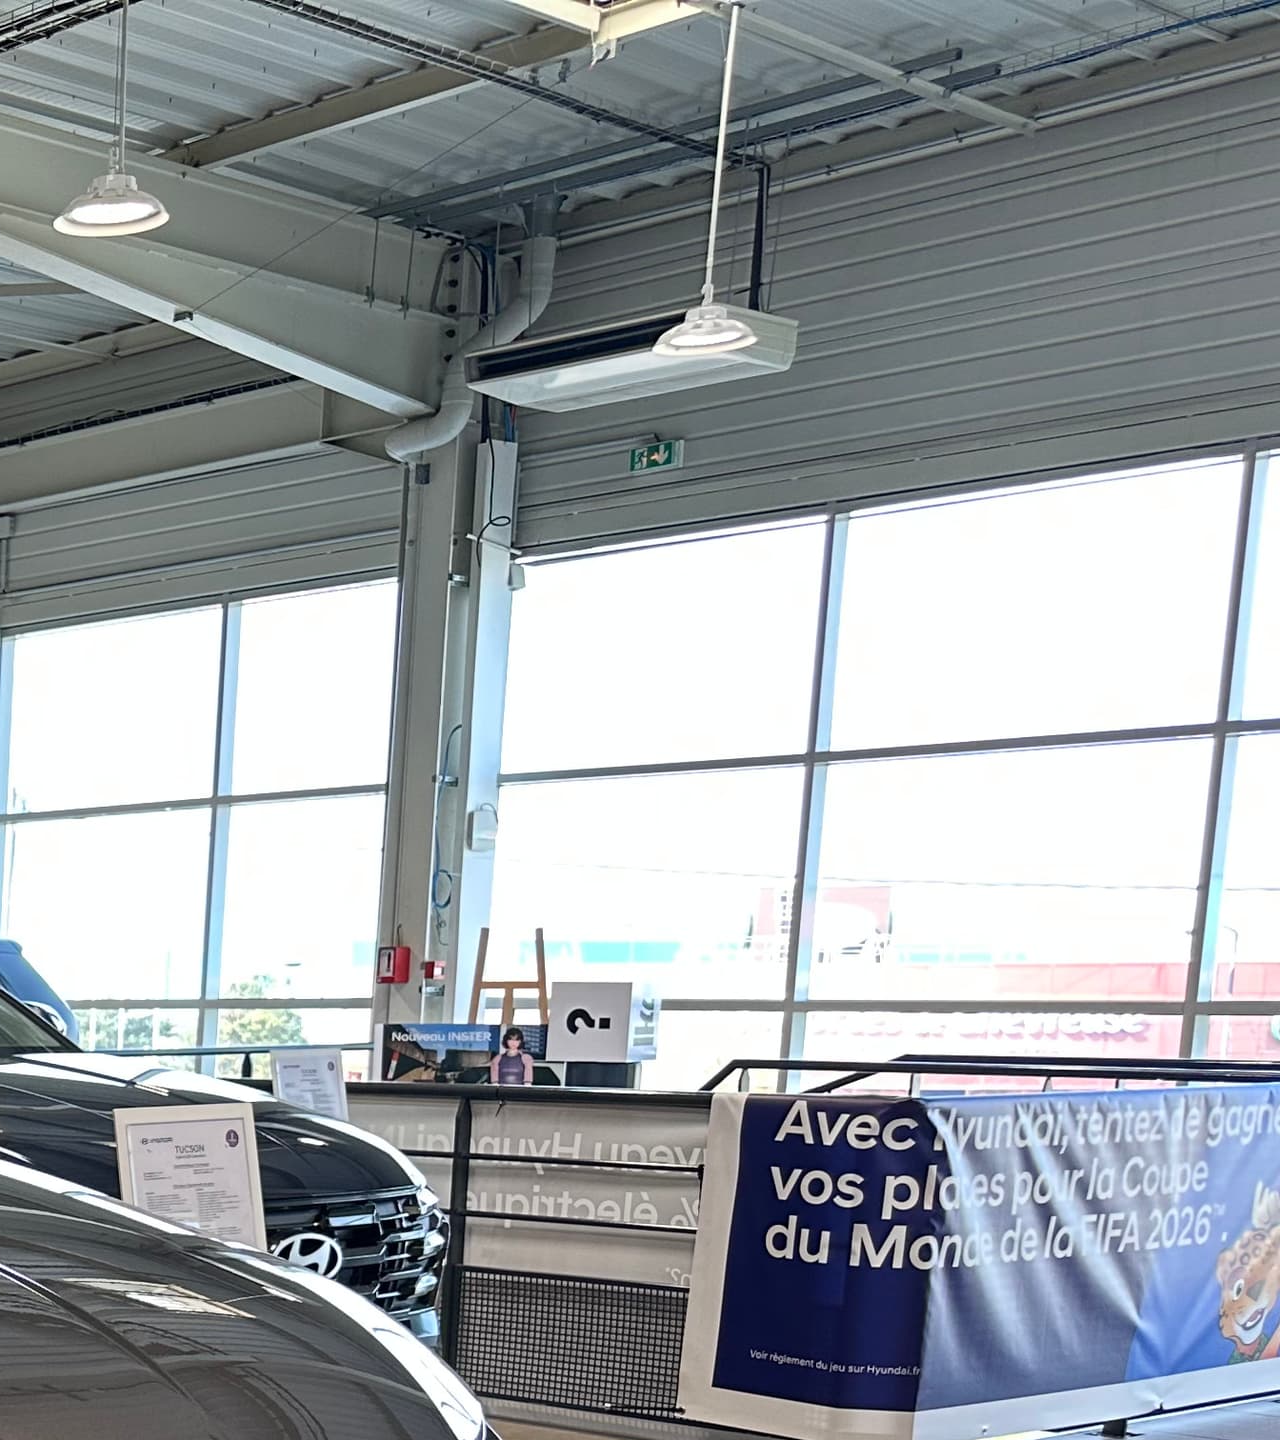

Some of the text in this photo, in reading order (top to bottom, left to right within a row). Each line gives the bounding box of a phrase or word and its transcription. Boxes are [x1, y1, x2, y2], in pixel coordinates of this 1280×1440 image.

[392, 1031, 492, 1042] Nouveau INSTER
[774, 1100, 918, 1150] Avec
[1077, 1102, 1164, 1143] tentez
[174, 1144, 205, 1153] TUCSON
[770, 1164, 864, 1208] vos
[1086, 1158, 1115, 1200] la
[1122, 1156, 1209, 1209] Coupe
[765, 1215, 829, 1264] du
[1001, 1217, 1038, 1262] de
[1044, 1214, 1074, 1259] la
[1081, 1211, 1140, 1254] FIFA
[749, 1348, 921, 1377] Voir règlement du jeu sur Hyundai.fr
